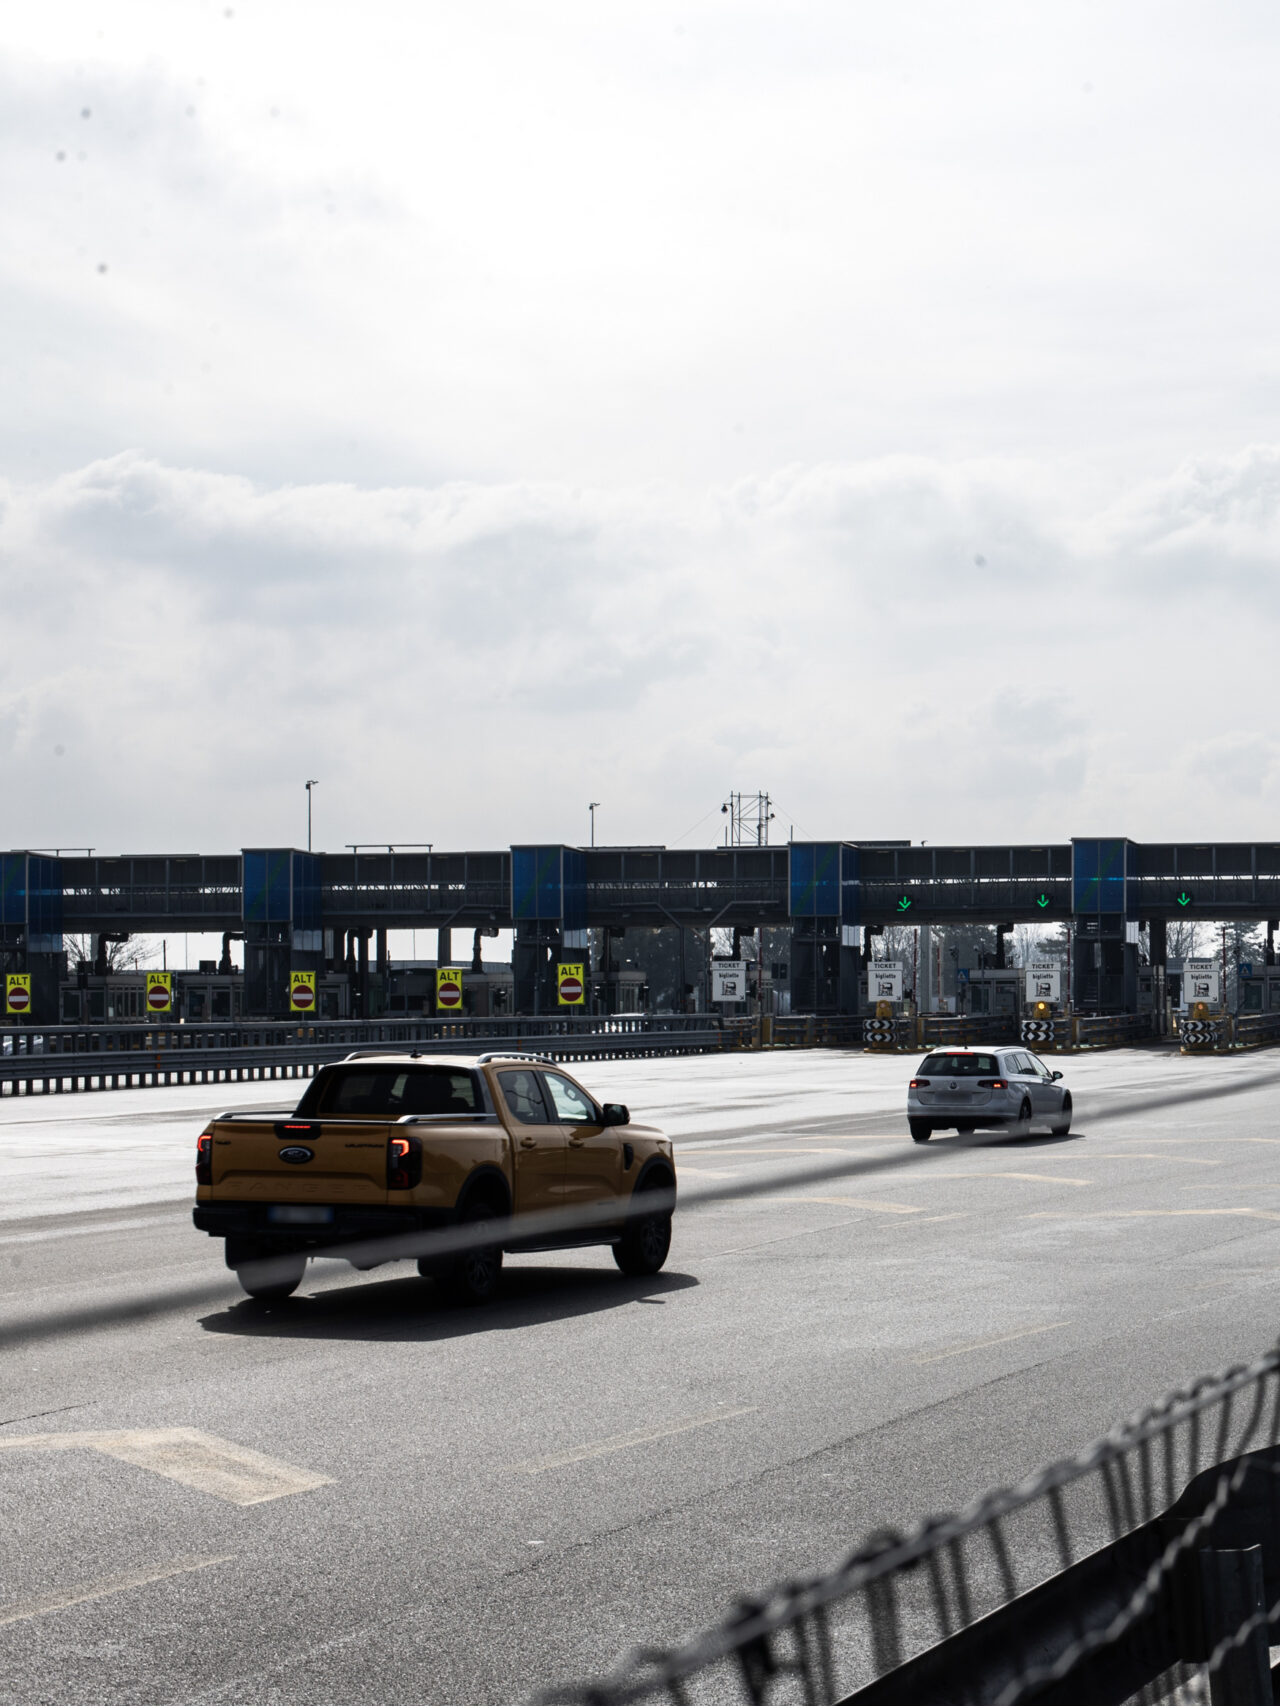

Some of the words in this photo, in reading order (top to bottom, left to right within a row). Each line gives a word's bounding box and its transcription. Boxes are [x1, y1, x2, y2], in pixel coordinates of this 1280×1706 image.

[561, 967, 580, 976] ALT
[149, 975, 168, 984] ALT
[293, 975, 312, 983] ALT
[440, 972, 459, 980] ALT
[9, 977, 28, 985] ALT
